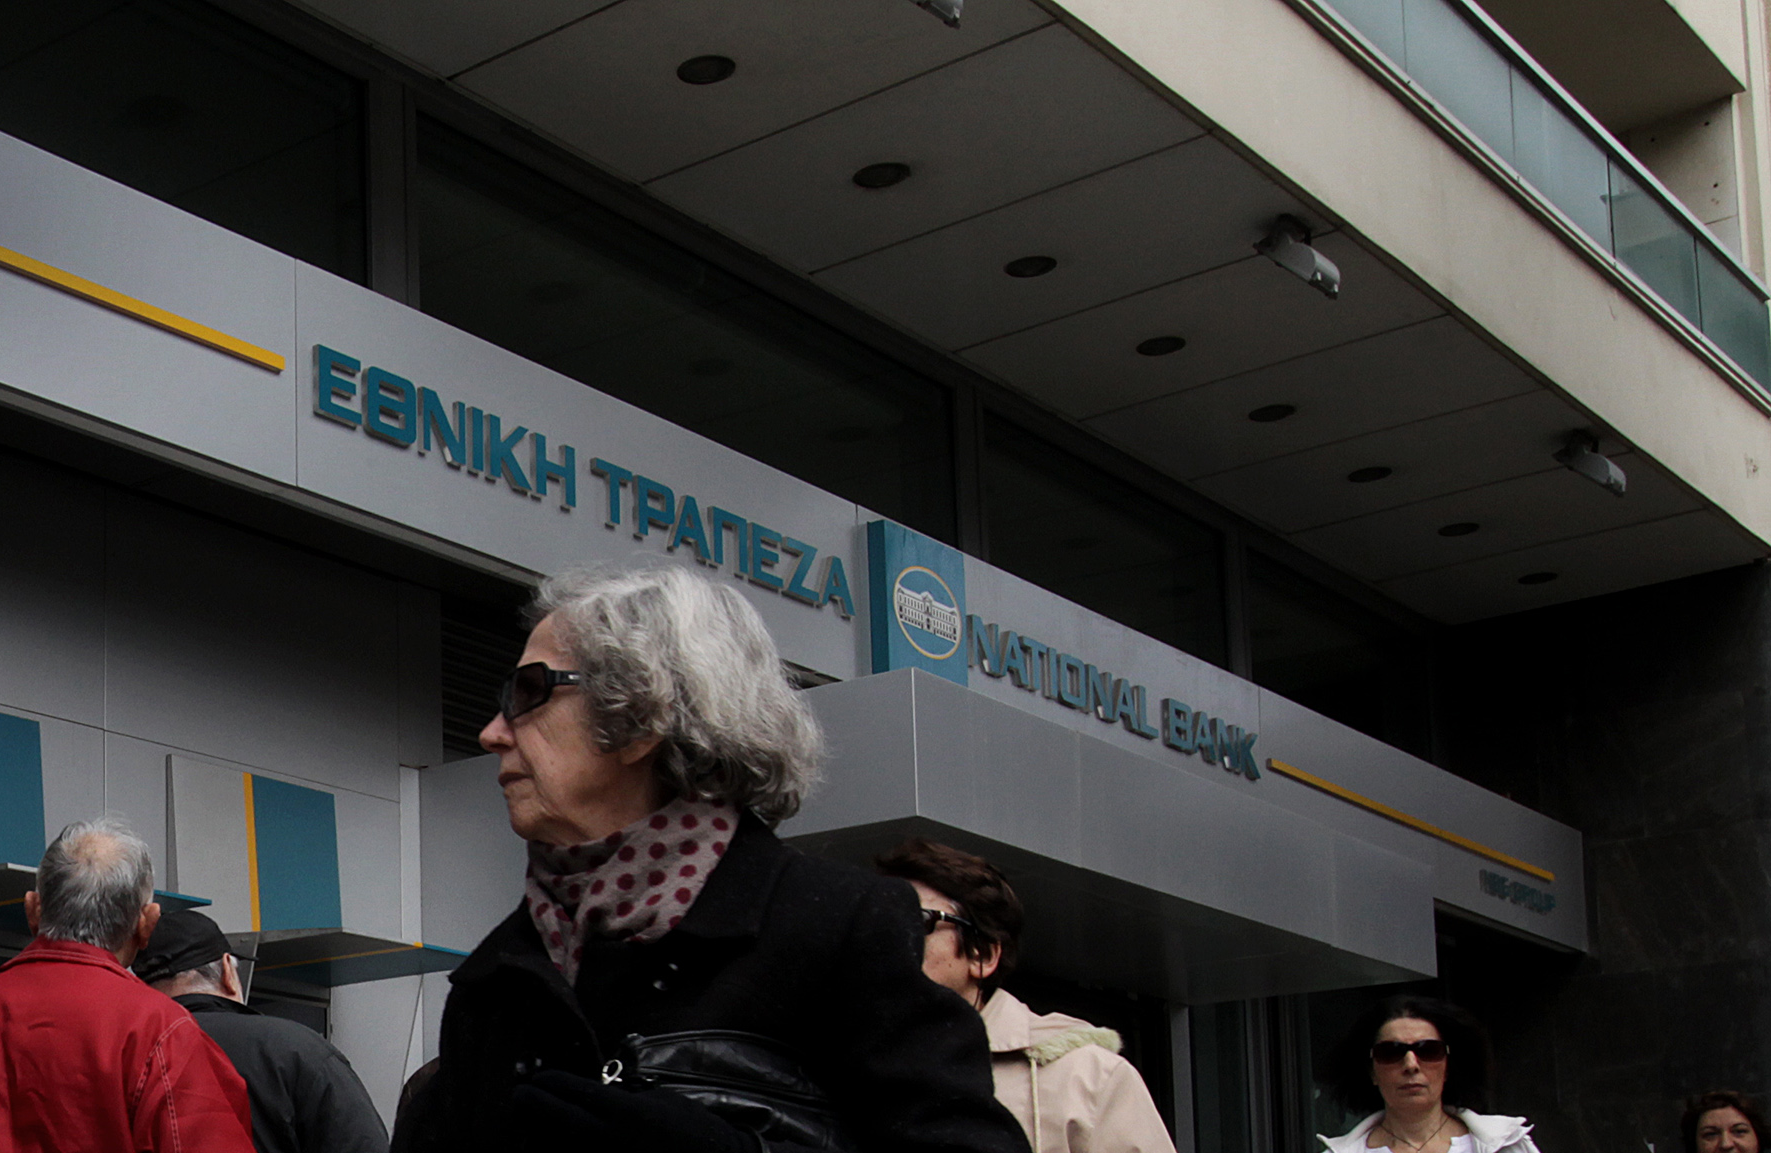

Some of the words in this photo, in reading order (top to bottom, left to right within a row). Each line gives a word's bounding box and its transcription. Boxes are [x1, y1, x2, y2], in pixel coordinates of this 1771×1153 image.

[312, 344, 576, 512] ΕΘΝΙΚΗ
[590, 457, 856, 621] ΤΡΑΠΕΖΑ
[966, 614, 1158, 740] NATIONAL
[1161, 698, 1261, 780] BANK
